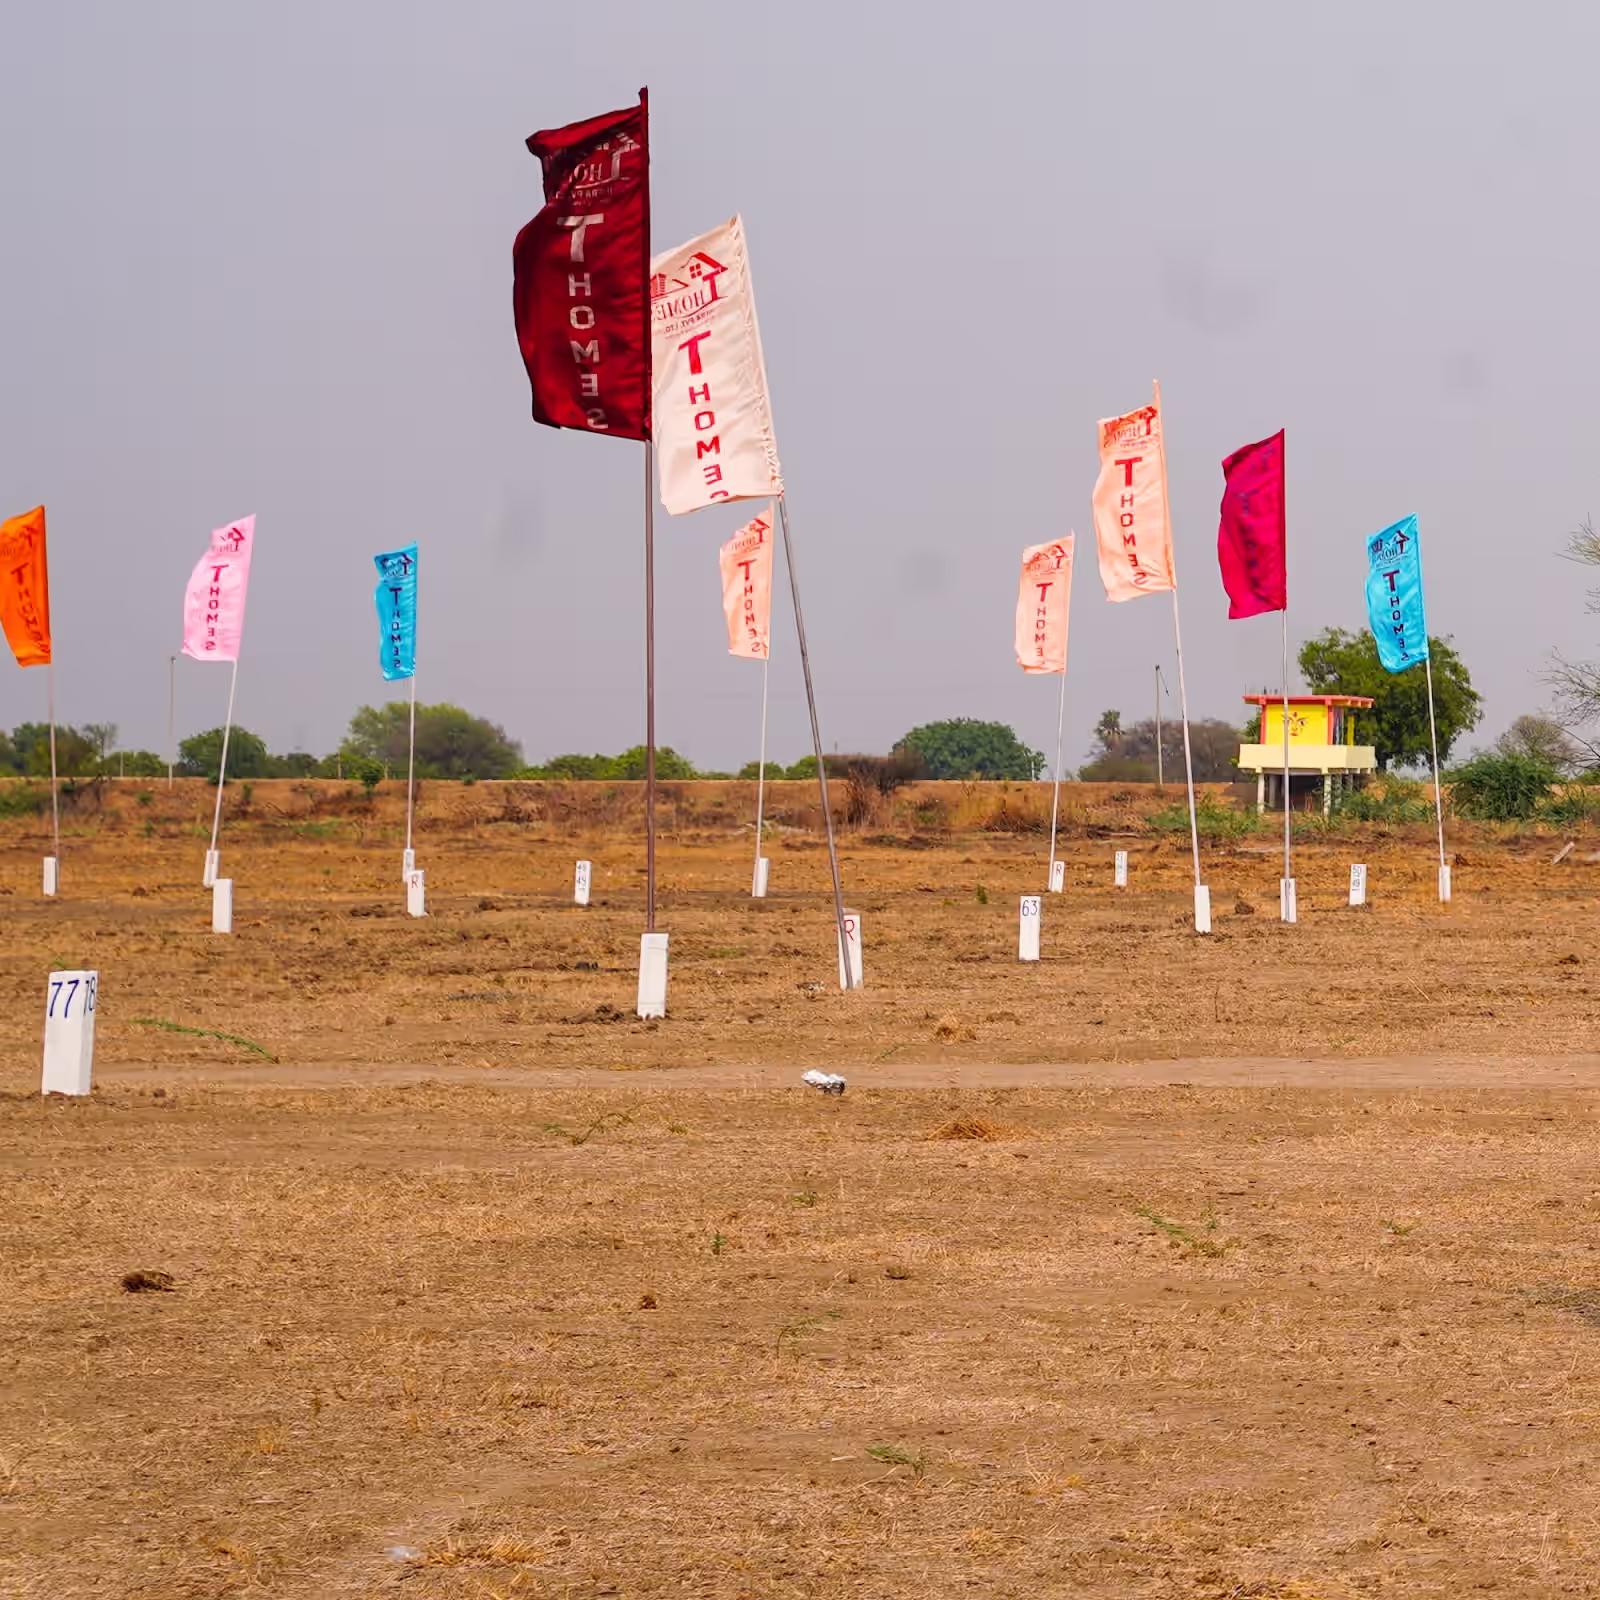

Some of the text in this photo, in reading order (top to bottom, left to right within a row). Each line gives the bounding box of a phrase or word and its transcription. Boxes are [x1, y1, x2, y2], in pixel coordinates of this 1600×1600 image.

[411, 875, 418, 889] R
[1022, 899, 1038, 917] 63
[49, 979, 80, 1019] 77
